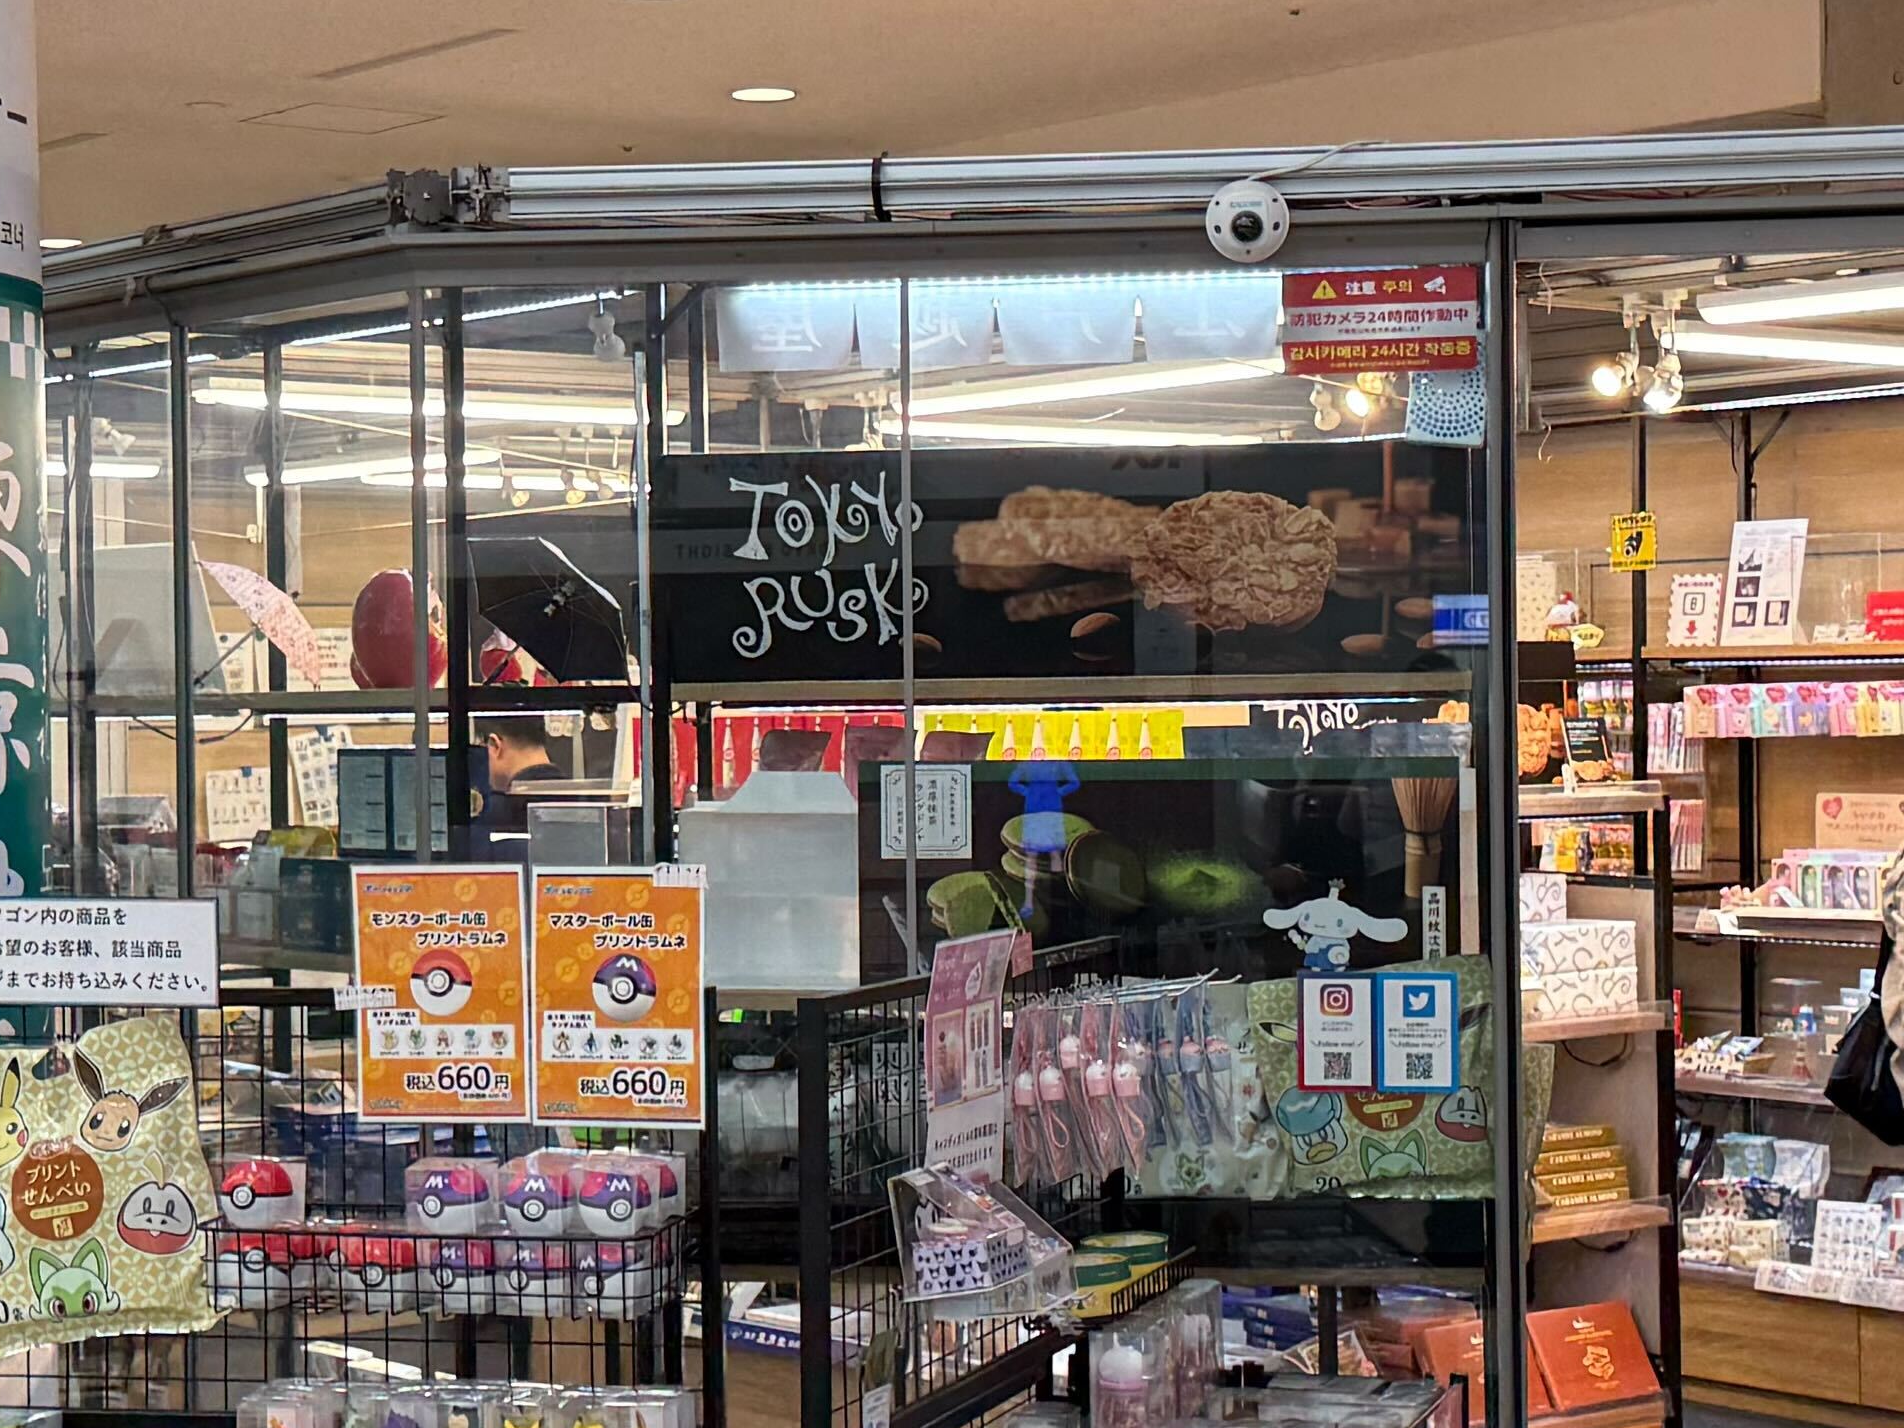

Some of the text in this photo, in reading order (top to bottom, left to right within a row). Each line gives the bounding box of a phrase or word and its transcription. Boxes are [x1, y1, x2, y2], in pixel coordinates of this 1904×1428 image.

[0, 221, 24, 252] 코너
[1345, 280, 1413, 295] 注意 주의
[1289, 308, 1469, 327] 防犯カメラ24時間作動中
[1371, 341, 1420, 358] 24시간
[729, 471, 924, 567] TOKYO
[732, 558, 929, 658] RUSK
[372, 913, 487, 926] モンスターボール缶
[550, 914, 653, 928] マスターボール缶
[417, 933, 506, 946] プリントラムネ
[594, 934, 686, 948] プリントラムネ
[26, 1160, 81, 1184] プリント
[21, 1181, 91, 1206] せんべい
